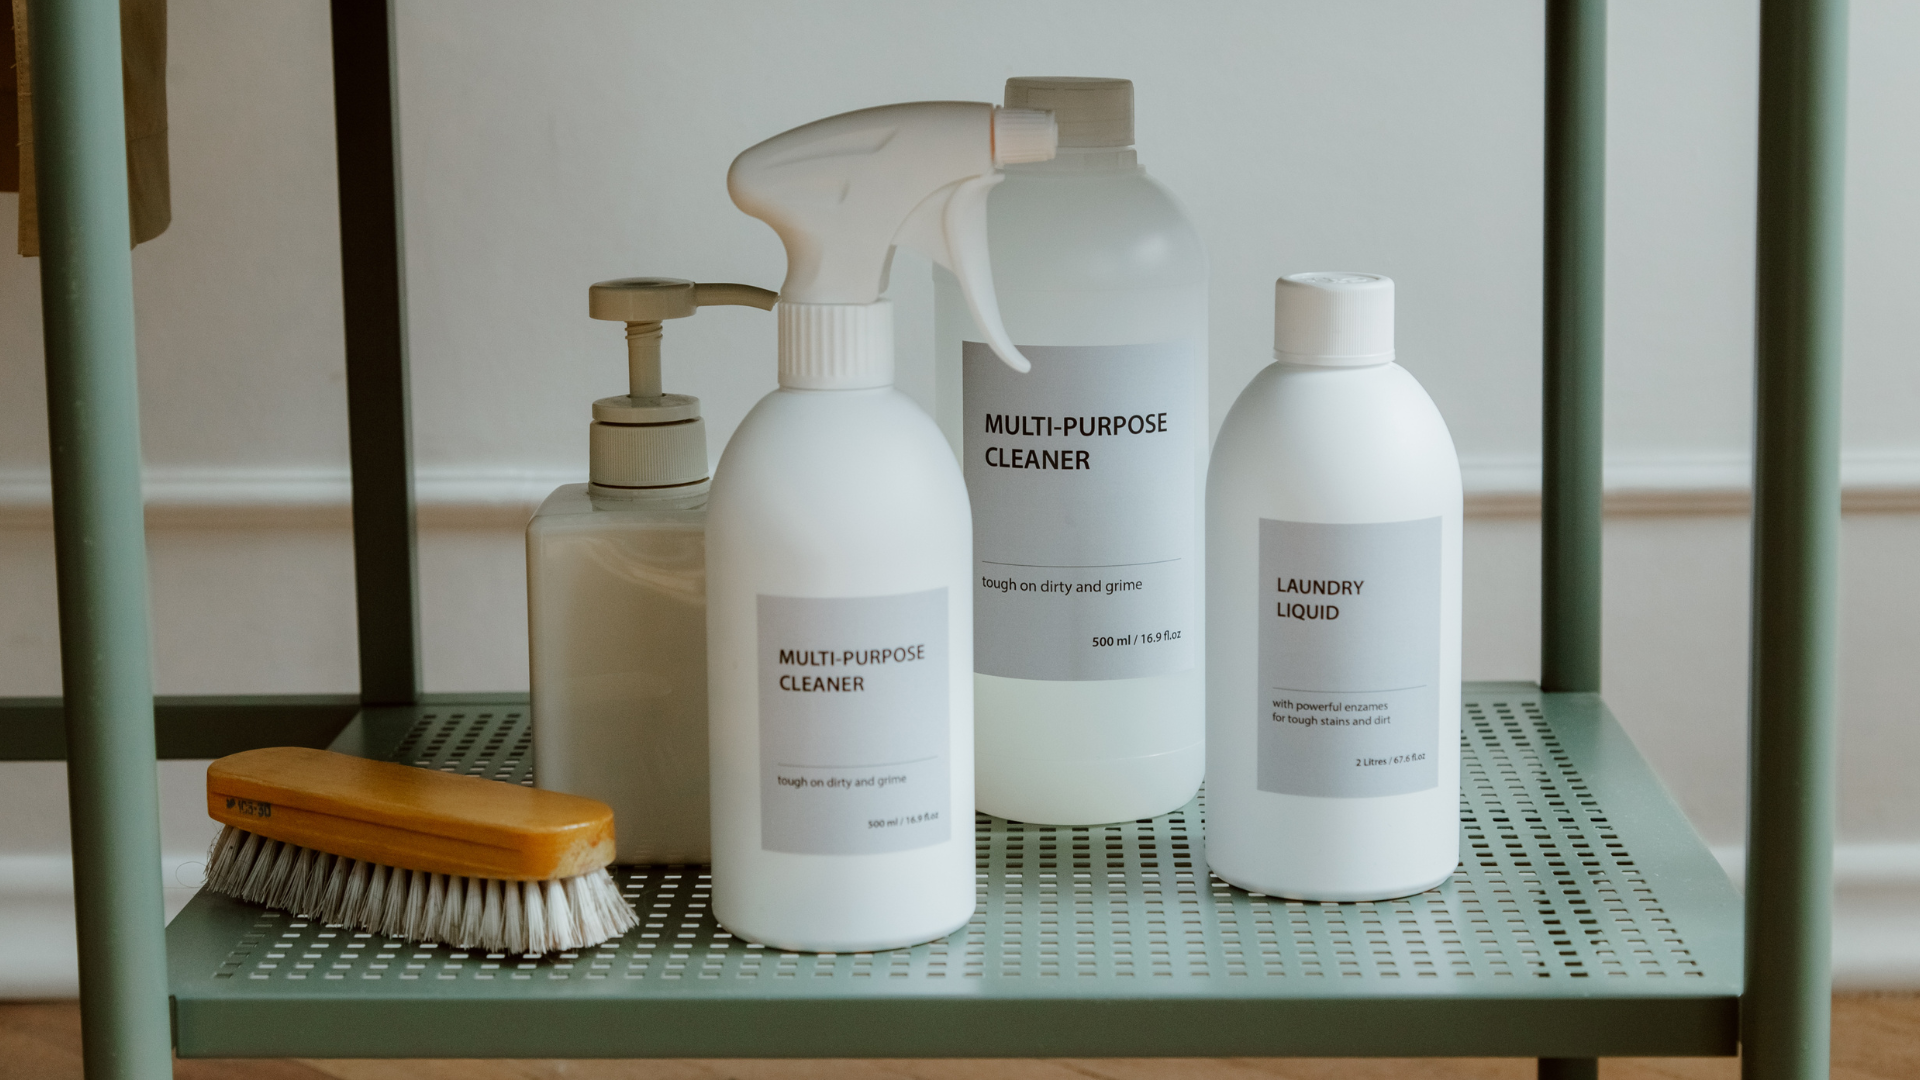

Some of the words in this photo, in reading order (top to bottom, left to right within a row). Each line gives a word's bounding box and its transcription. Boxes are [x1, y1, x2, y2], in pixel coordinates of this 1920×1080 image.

[985, 412, 1168, 437] MULTI-PURPOSE
[984, 446, 1091, 471] CLEANER
[981, 575, 1017, 594] tough
[1019, 581, 1037, 593] on
[1040, 579, 1073, 596] dirty
[1075, 579, 1102, 593] and
[1105, 579, 1143, 596] grime
[1277, 577, 1365, 596] LAUNDRY
[1277, 601, 1340, 621] LIQUID
[1092, 636, 1115, 648] 500
[1116, 634, 1131, 647] ml
[1133, 634, 1139, 646] /
[1140, 631, 1162, 644] 16.9
[1163, 629, 1182, 641] fl.oz
[778, 644, 925, 667] MULTI-PURPOSE
[778, 674, 865, 693] CLEANER
[1272, 698, 1294, 712] with
[1295, 701, 1343, 713] powerful
[1343, 702, 1389, 713] enzames
[1271, 711, 1286, 723] for
[1287, 714, 1319, 728] tough
[1320, 716, 1351, 727] stains
[1352, 715, 1372, 726] and
[1373, 715, 1391, 726] dirt
[1355, 758, 1362, 767] 2
[1363, 757, 1388, 767] Litres
[1393, 754, 1411, 765] 67.6
[1411, 752, 1426, 762] fl.oz
[777, 775, 809, 790] tough
[809, 778, 825, 788] on
[825, 776, 853, 790] dirty
[854, 775, 876, 788] and
[876, 774, 908, 789] grime
[867, 819, 886, 829] 500
[886, 817, 899, 828] ml
[905, 813, 924, 825] 16.9
